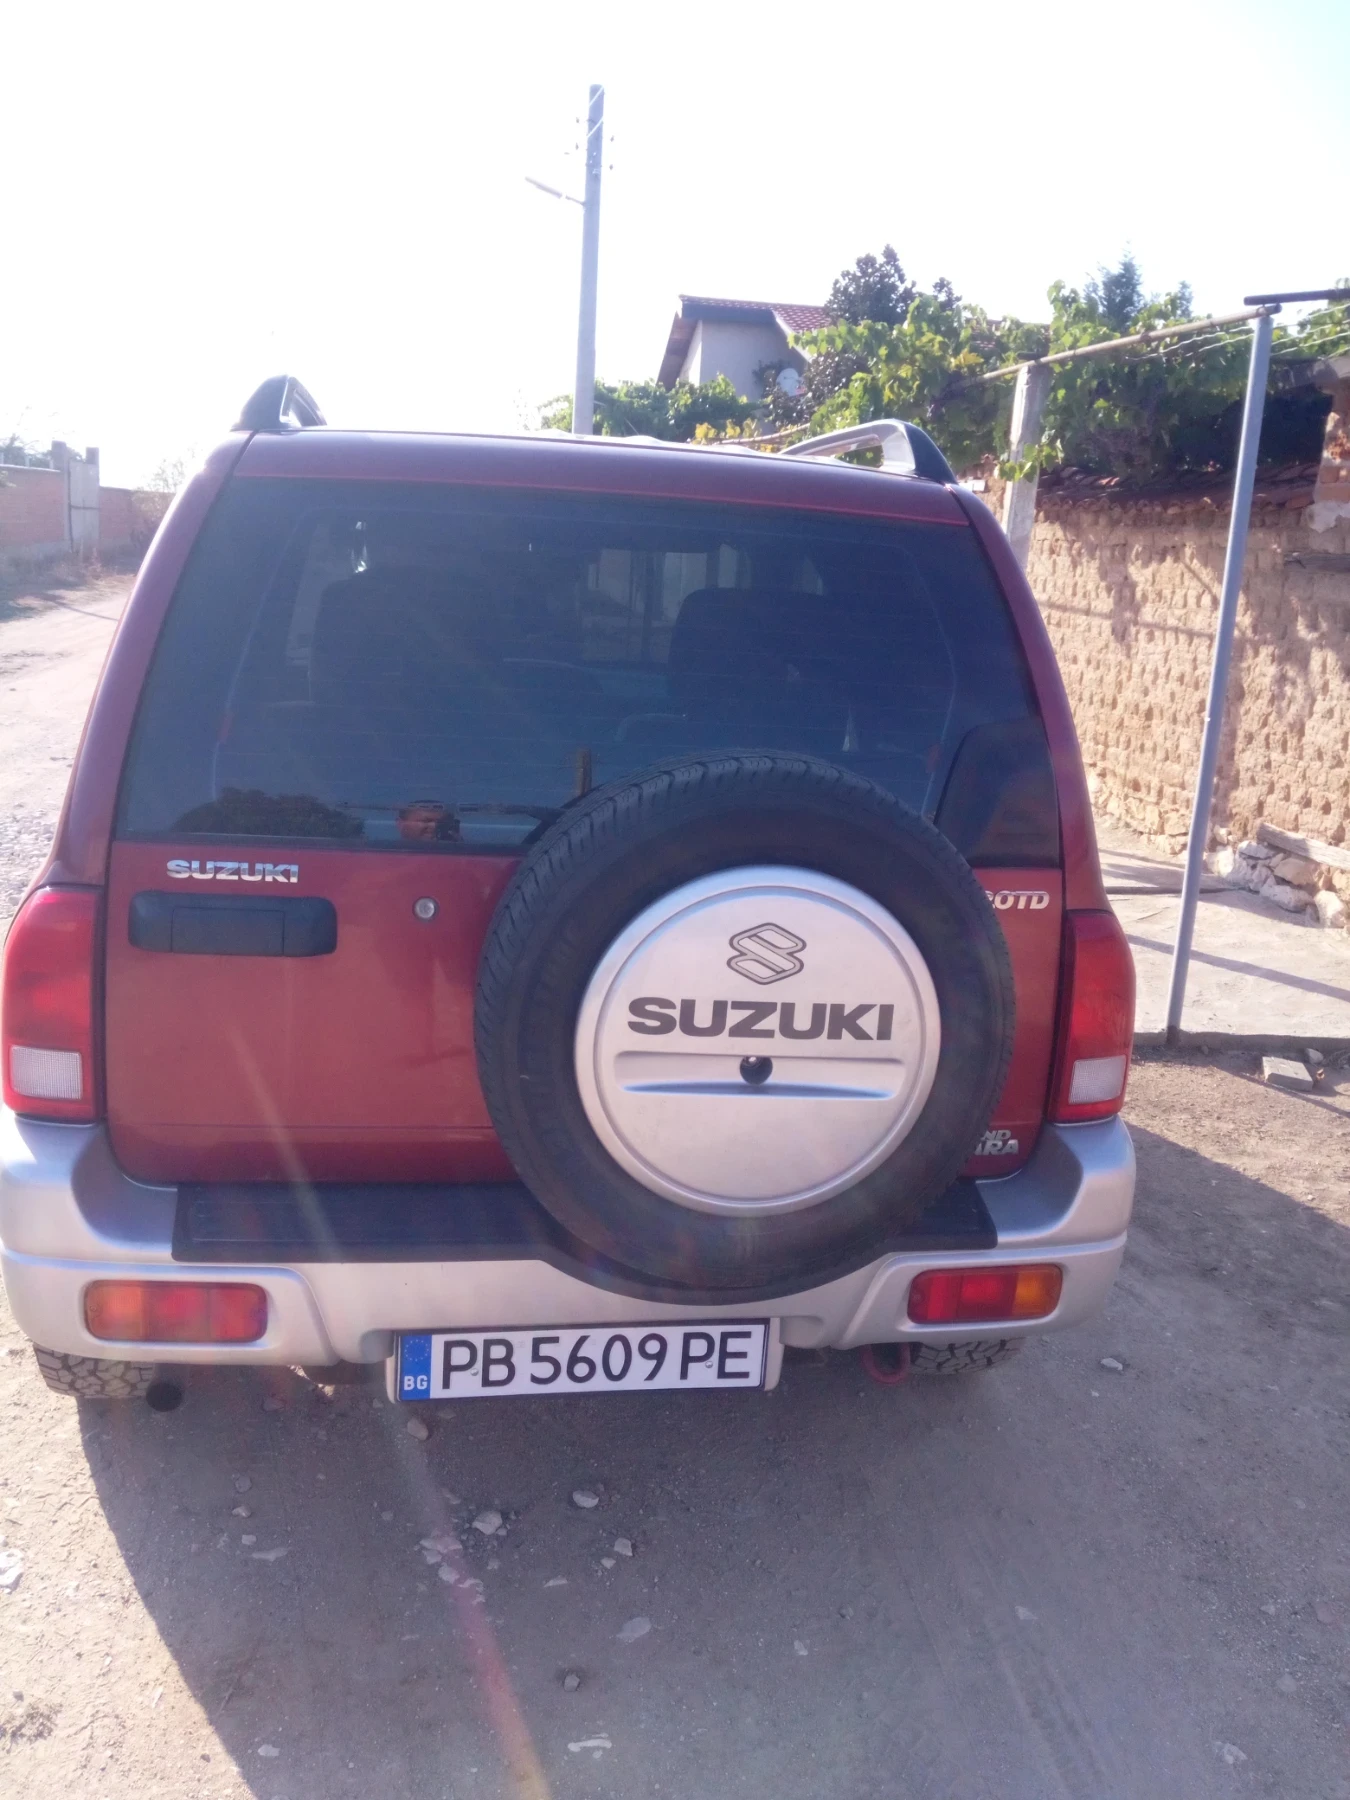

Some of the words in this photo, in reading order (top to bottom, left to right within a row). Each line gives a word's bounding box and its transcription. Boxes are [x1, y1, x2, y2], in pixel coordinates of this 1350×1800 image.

[166, 859, 299, 883] SUZUKI
[627, 996, 895, 1041] SUZUKI
[442, 1338, 516, 1390] PB
[530, 1332, 669, 1386] 5609
[680, 1330, 752, 1381] PE
[403, 1375, 428, 1391] BG
